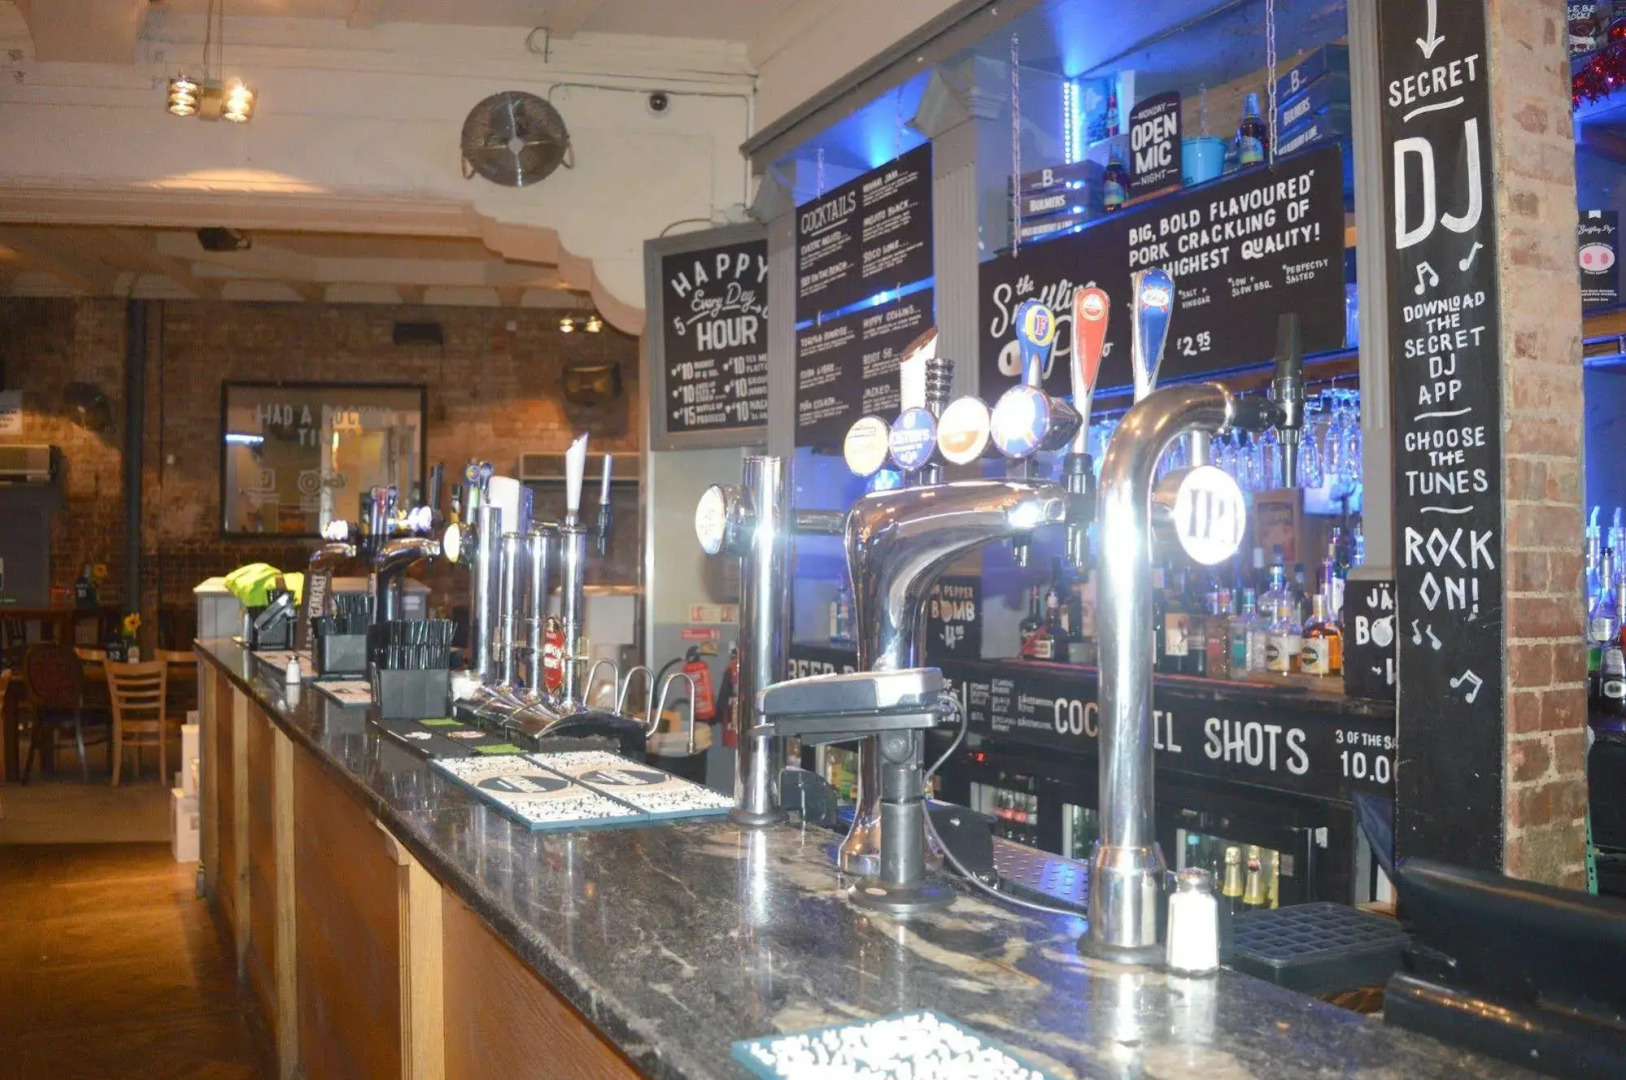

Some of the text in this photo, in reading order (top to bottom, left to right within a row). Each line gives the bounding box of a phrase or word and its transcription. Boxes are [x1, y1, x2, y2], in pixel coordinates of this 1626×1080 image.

[1389, 54, 1478, 107] SECRET
[1138, 102, 1166, 120] MONDAY
[1131, 112, 1177, 152] OPEN
[1136, 140, 1172, 174] MIC
[1140, 169, 1167, 186] NIGHT
[1394, 118, 1482, 249] DJ
[801, 190, 856, 235] COCKTAILS
[1129, 224, 1156, 246] BIG,
[1160, 209, 1201, 237] BOLD
[1129, 199, 1310, 268] PORK CRACKLING OF
[1162, 246, 1230, 279] HIGHEST
[1241, 222, 1320, 261] QUALITY!
[671, 252, 768, 298] HAPPY
[1016, 274, 1035, 295] the
[1231, 285, 1252, 297] SLOW
[1285, 272, 1315, 284] SALTED
[691, 289, 723, 317] Every
[726, 282, 756, 313] Day
[1181, 295, 1211, 309] VINEGAR
[1403, 291, 1486, 323] DOWNLOAD
[673, 316, 686, 336] 5
[697, 315, 759, 352] HOUR
[1035, 314, 1049, 335] F
[1426, 313, 1461, 334] THE
[1405, 326, 1486, 358] SECRET
[1429, 353, 1456, 378] DJ
[1418, 379, 1462, 405] APP
[257, 403, 293, 426] HAD
[300, 403, 312, 426] A
[1405, 426, 1486, 452] CHOOSE
[1429, 450, 1465, 466] THE
[1405, 469, 1488, 496] TUNES
[1405, 526, 1495, 571] ROCK
[1420, 572, 1479, 614] ON!
[931, 599, 975, 622] BOMB
[1054, 698, 1181, 754] COCIL
[1335, 729, 1344, 744] 3
[1347, 731, 1360, 745] OF
[1361, 733, 1382, 747] THE
[1204, 717, 1310, 776] SHOTS
[1340, 750, 1398, 784] 10.0
